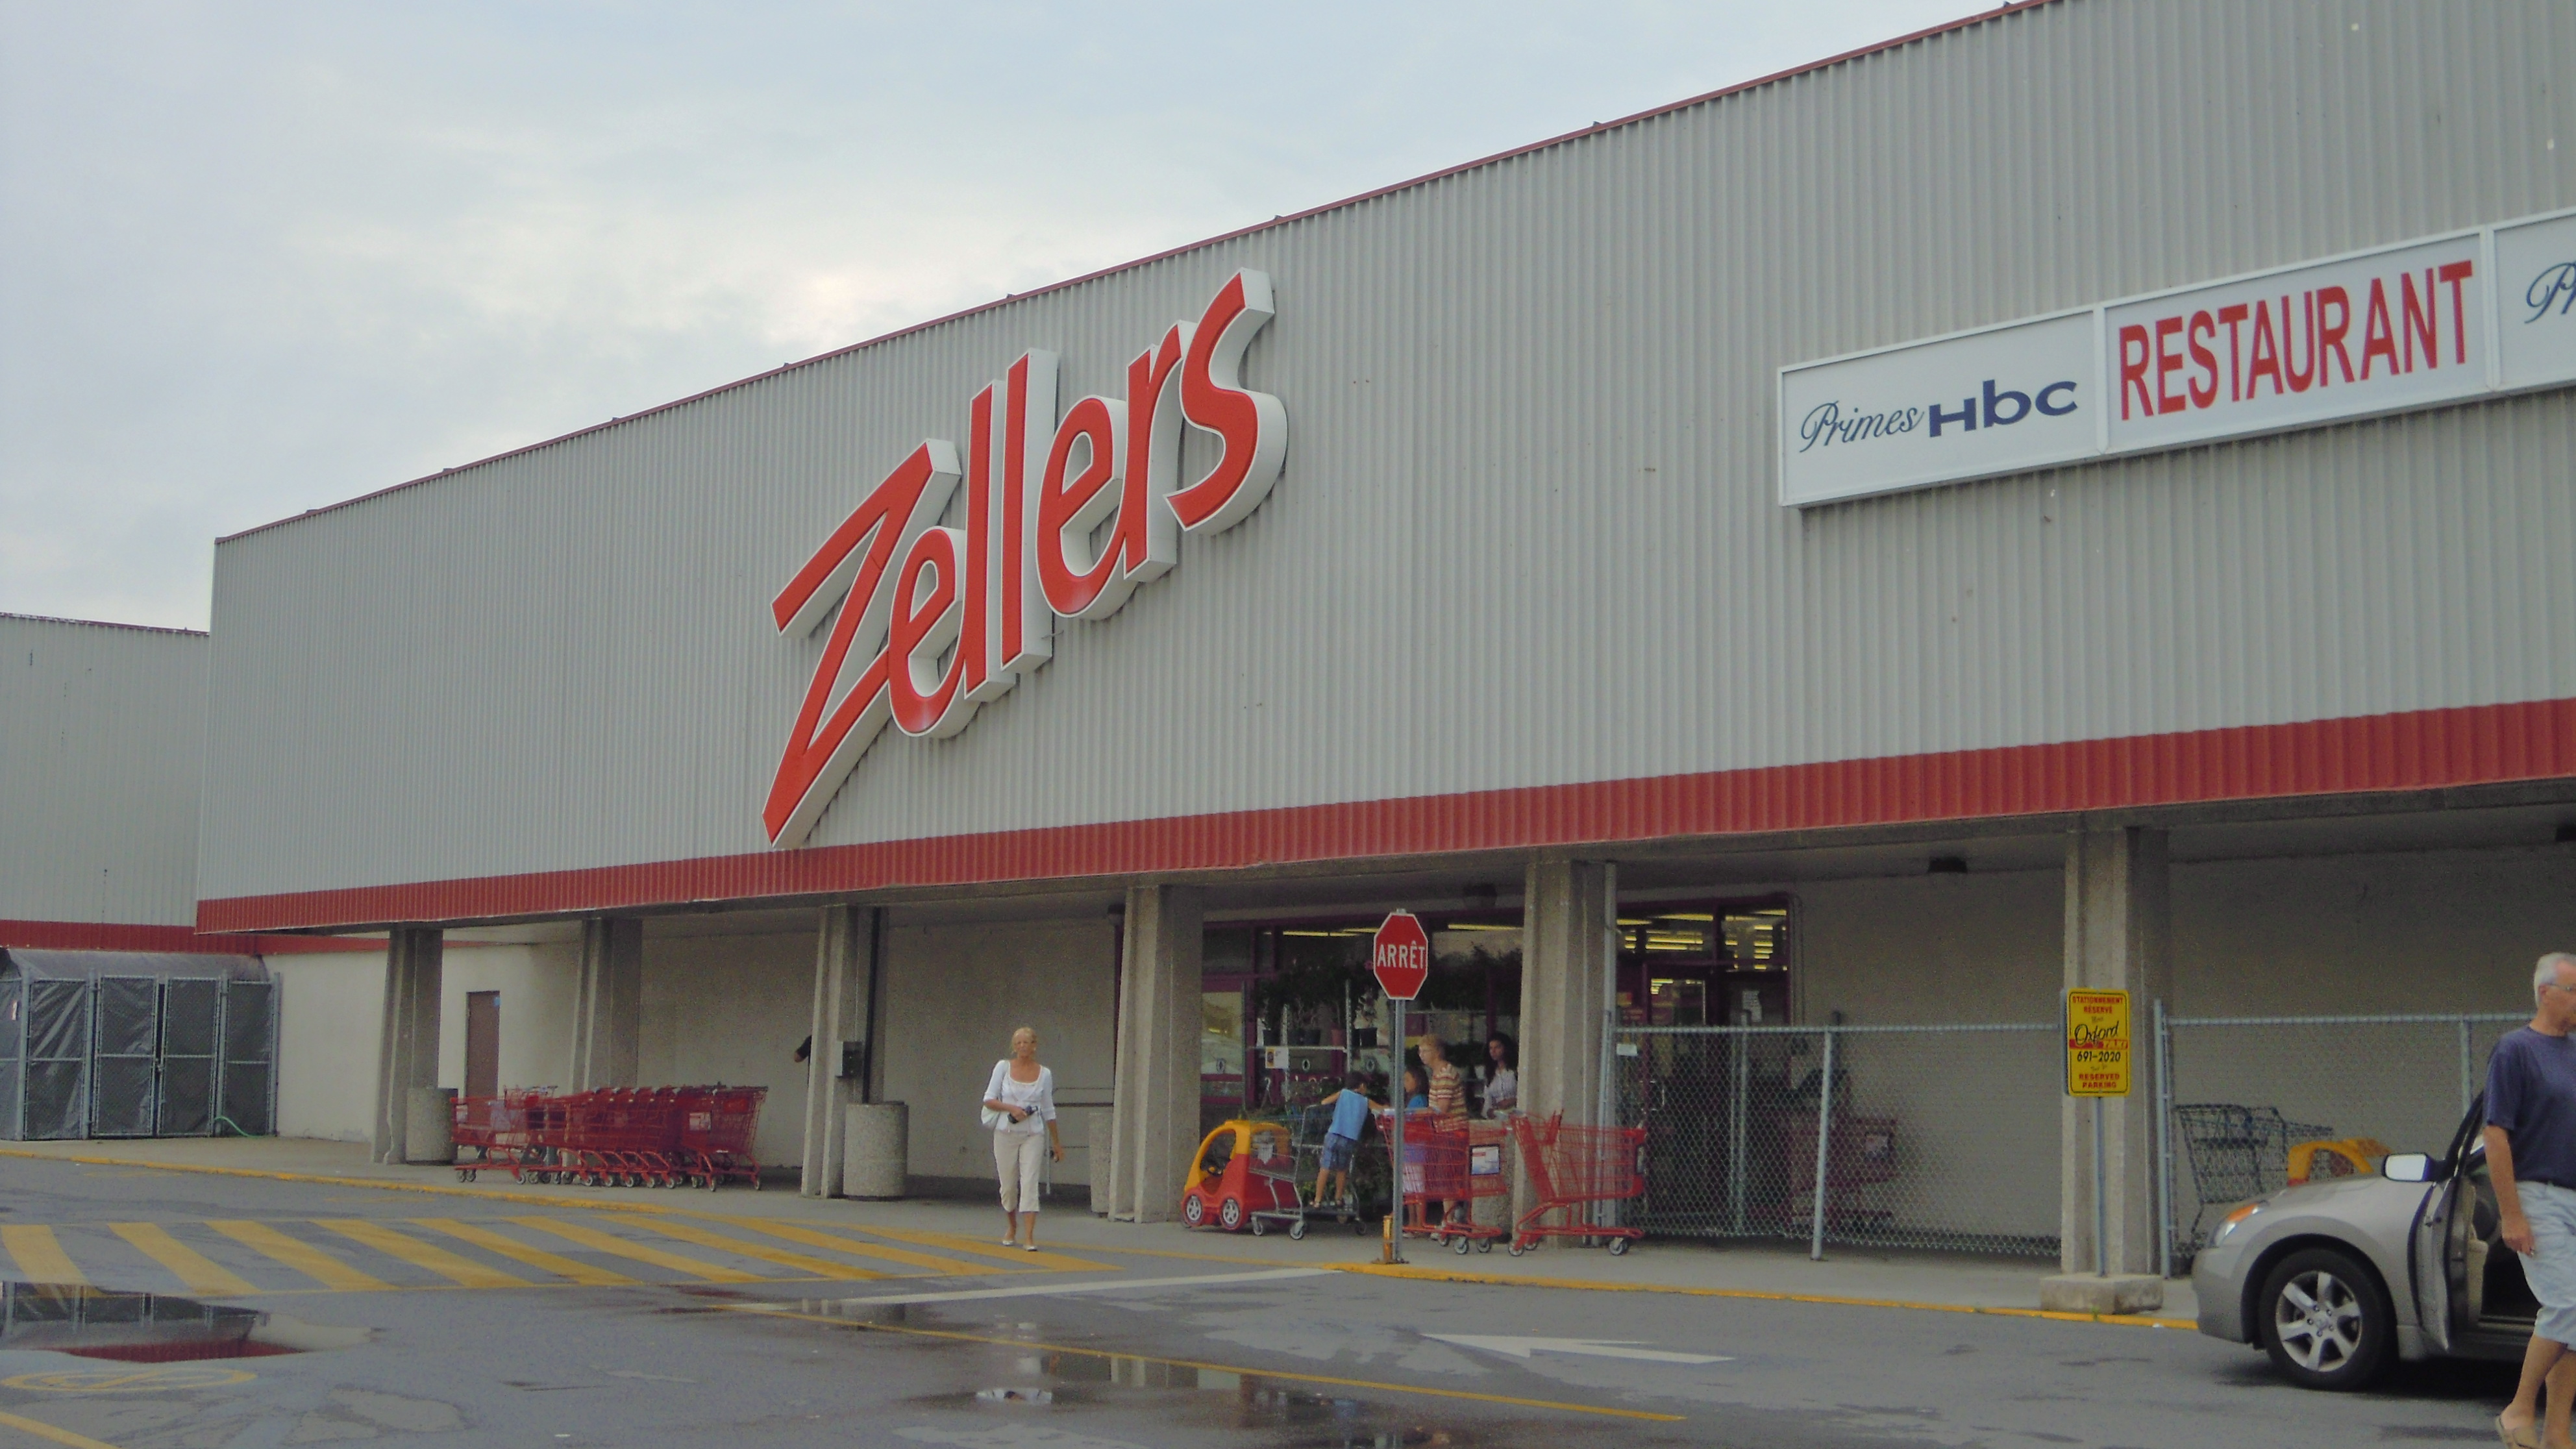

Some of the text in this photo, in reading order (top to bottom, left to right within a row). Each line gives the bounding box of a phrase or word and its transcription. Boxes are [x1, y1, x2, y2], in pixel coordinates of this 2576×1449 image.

[2119, 260, 2473, 421] RESTAURANT
[1800, 379, 2078, 452] Primes Hbc
[762, 267, 1280, 848] Zellers
[1377, 940, 1425, 969] ARRÊT
[2074, 1020, 2119, 1046] Oxford
[2077, 1051, 2121, 1062] 691-2020
